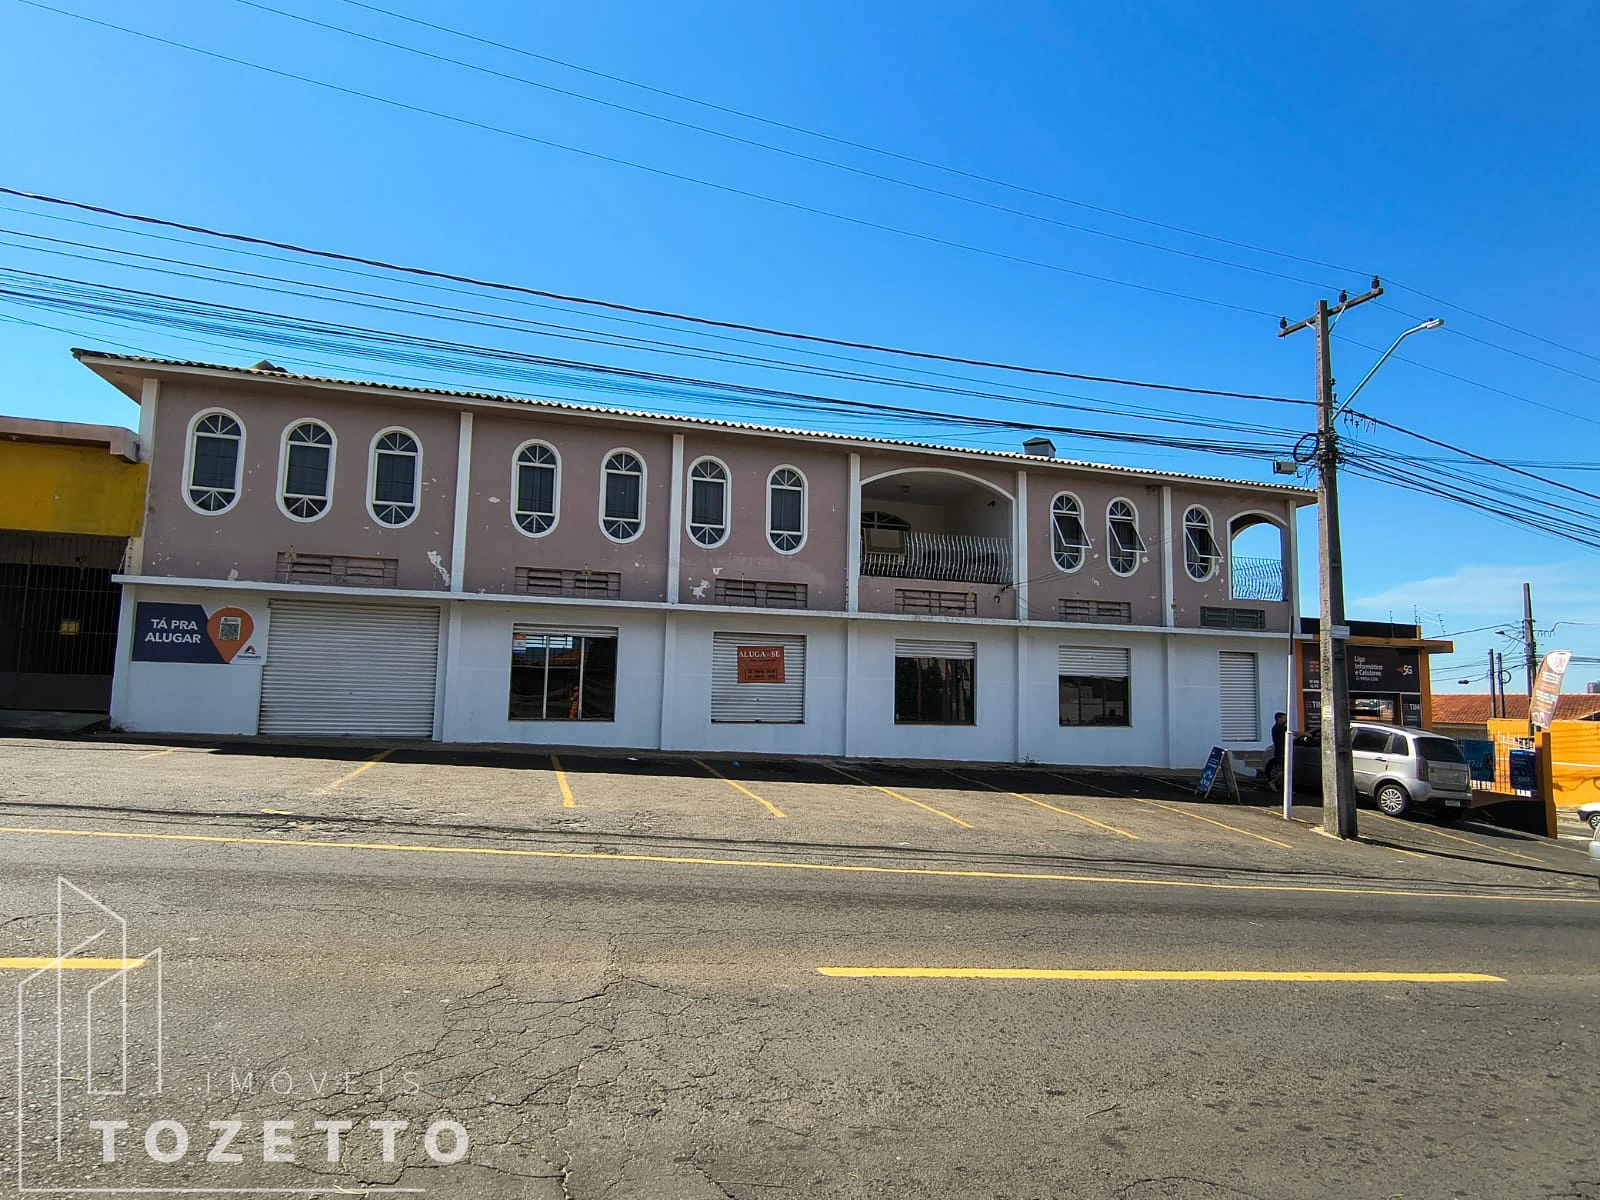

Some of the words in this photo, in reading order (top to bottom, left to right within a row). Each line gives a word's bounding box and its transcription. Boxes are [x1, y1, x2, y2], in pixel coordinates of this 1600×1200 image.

[151, 617, 168, 630] TÁ
[171, 619, 198, 631] PRA
[144, 632, 201, 644] ALUGAR
[1402, 664, 1413, 675] 5G
